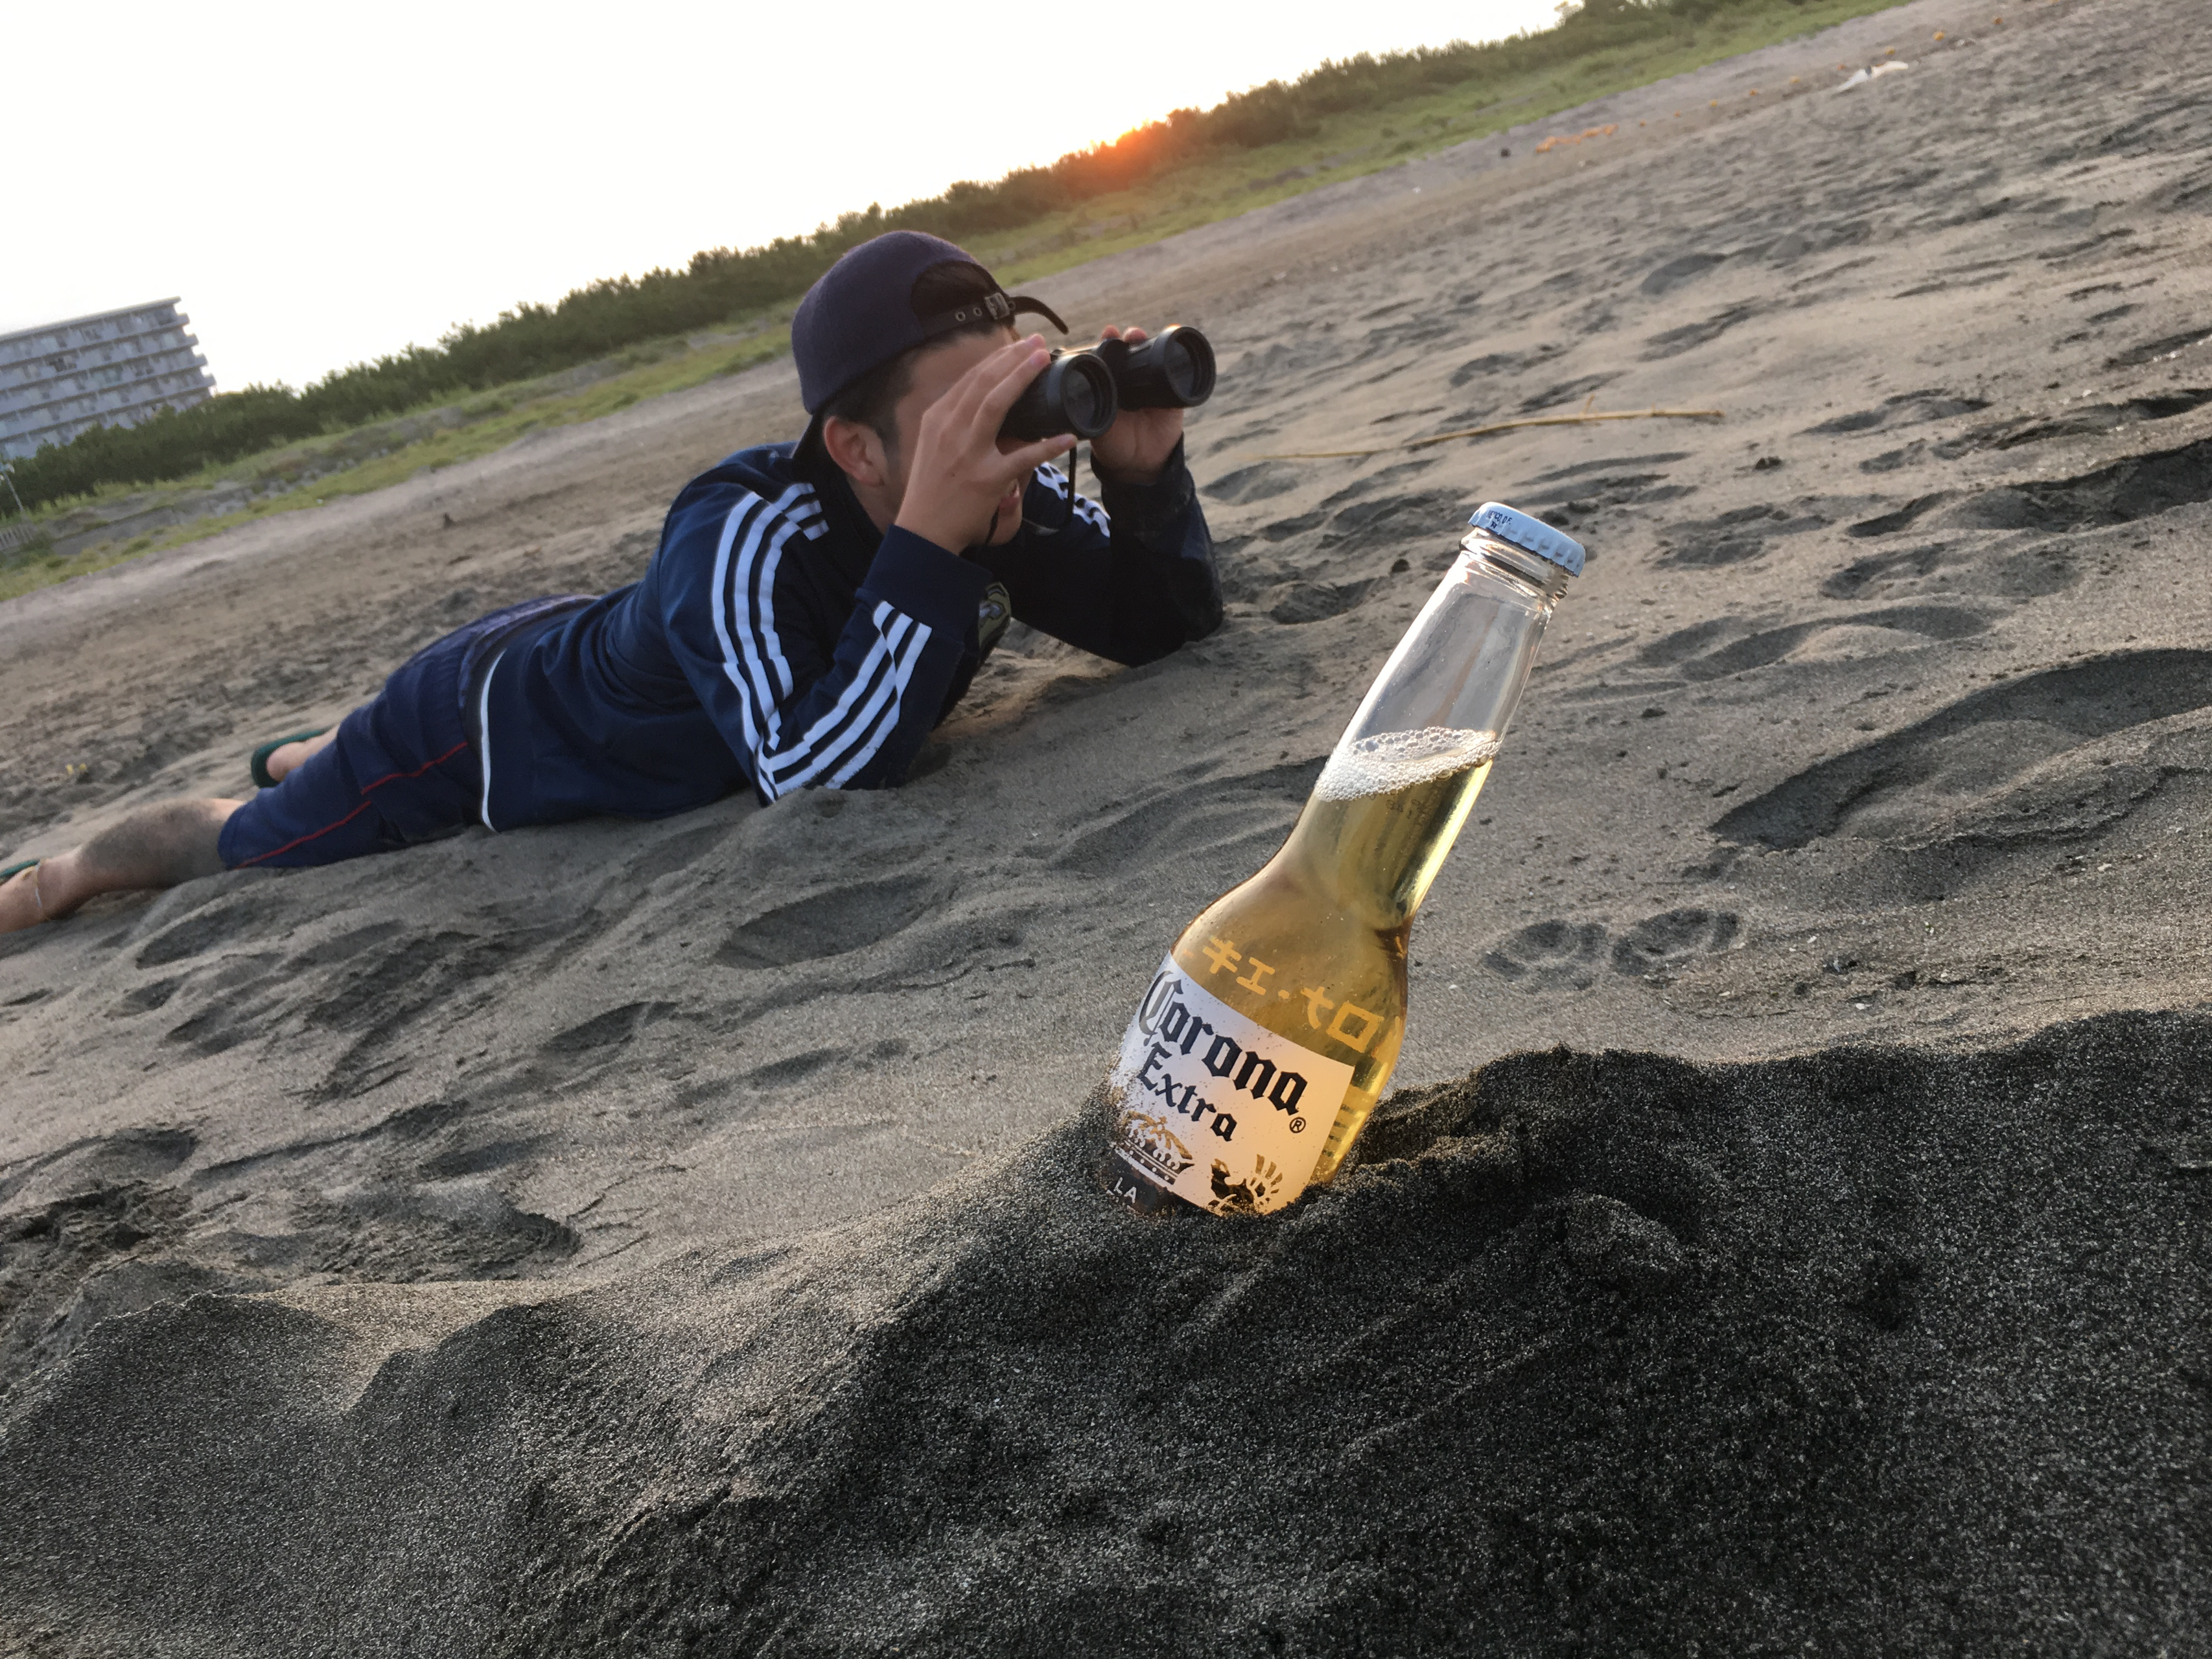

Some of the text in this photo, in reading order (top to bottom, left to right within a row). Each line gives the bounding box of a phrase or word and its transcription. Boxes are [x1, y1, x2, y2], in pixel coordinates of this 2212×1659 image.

[1136, 1041, 1238, 1142] Extra
[1139, 970, 1308, 1116] Corona
[1113, 1176, 1137, 1204] LA
